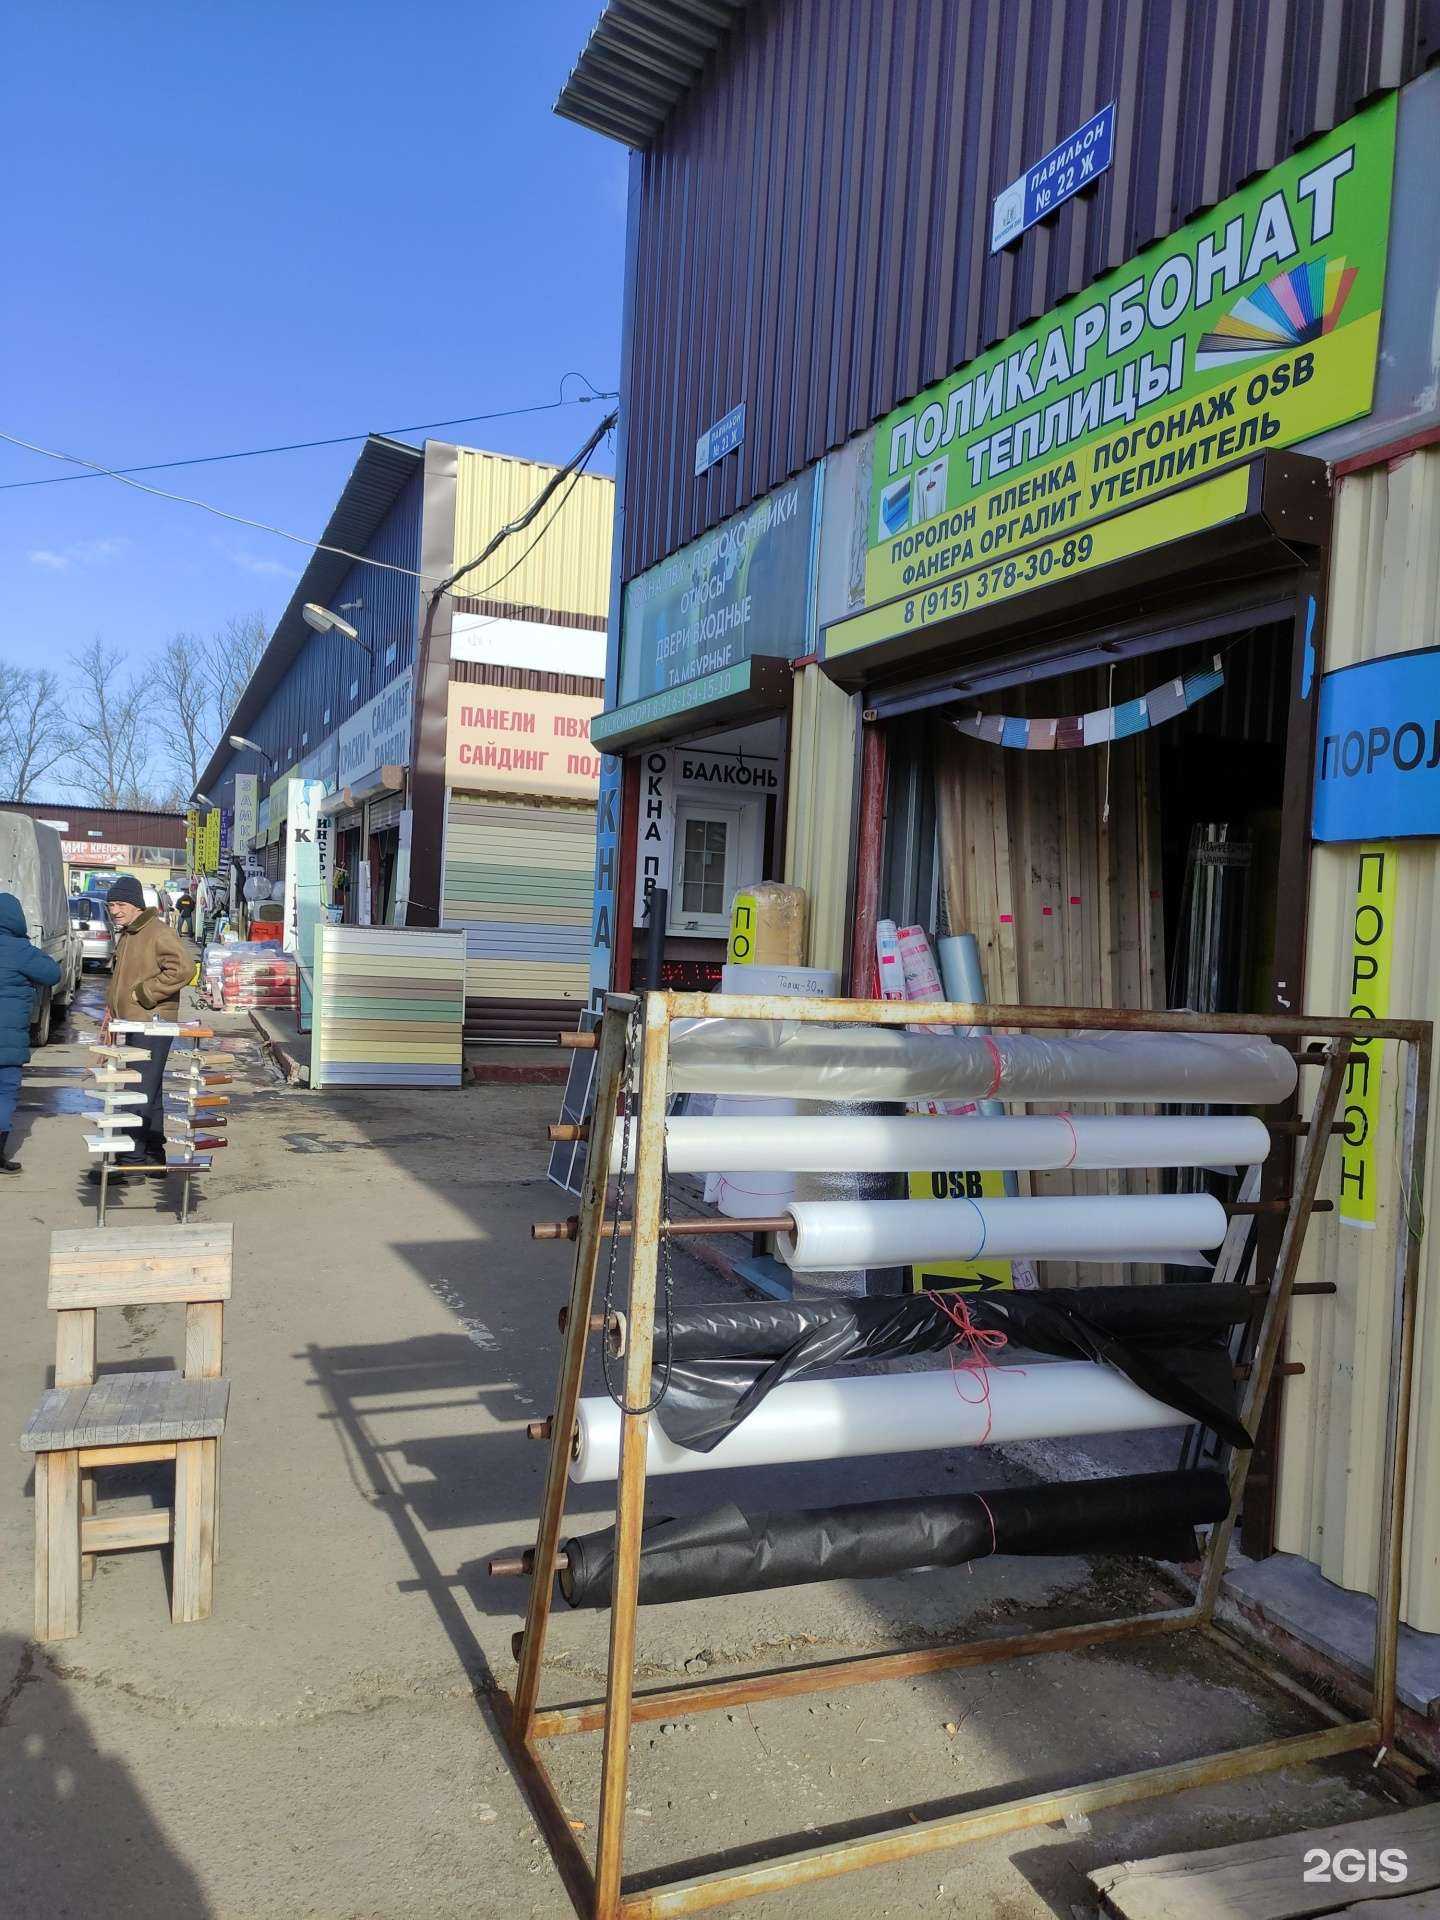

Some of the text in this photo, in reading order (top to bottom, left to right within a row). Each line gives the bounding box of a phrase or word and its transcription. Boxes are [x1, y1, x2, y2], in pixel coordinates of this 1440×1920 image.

[1031, 120, 1105, 191] ПАВИЛЬОН
[1036, 149, 1096, 212] № 22 Ж
[887, 145, 1356, 477] ПОЛИКАРБОНАТ
[966, 334, 1188, 487] ТЕПЛИЦЫ
[891, 352, 1315, 564] ПОРОЛОН ПЛЕНКА ПОГОНАЖ OSB
[902, 416, 1281, 587] ФАНЕРА ОРГАЛИТ УТЕПЛИТЕЛЬ
[692, 486, 799, 573] ПОДОКОННИКИ
[680, 570, 726, 615] ОТКОСЫ
[903, 532, 1094, 623] 8 (915) 378-30-89
[656, 596, 753, 665] ДВЕРИ ВХОДНЫЕ
[458, 740, 550, 773] САЙДИНГ
[460, 706, 590, 739] ПАНЕЛИ ПВХ
[643, 753, 666, 842] ОКНА
[1341, 852, 1385, 1202] ПОРОЛОН
